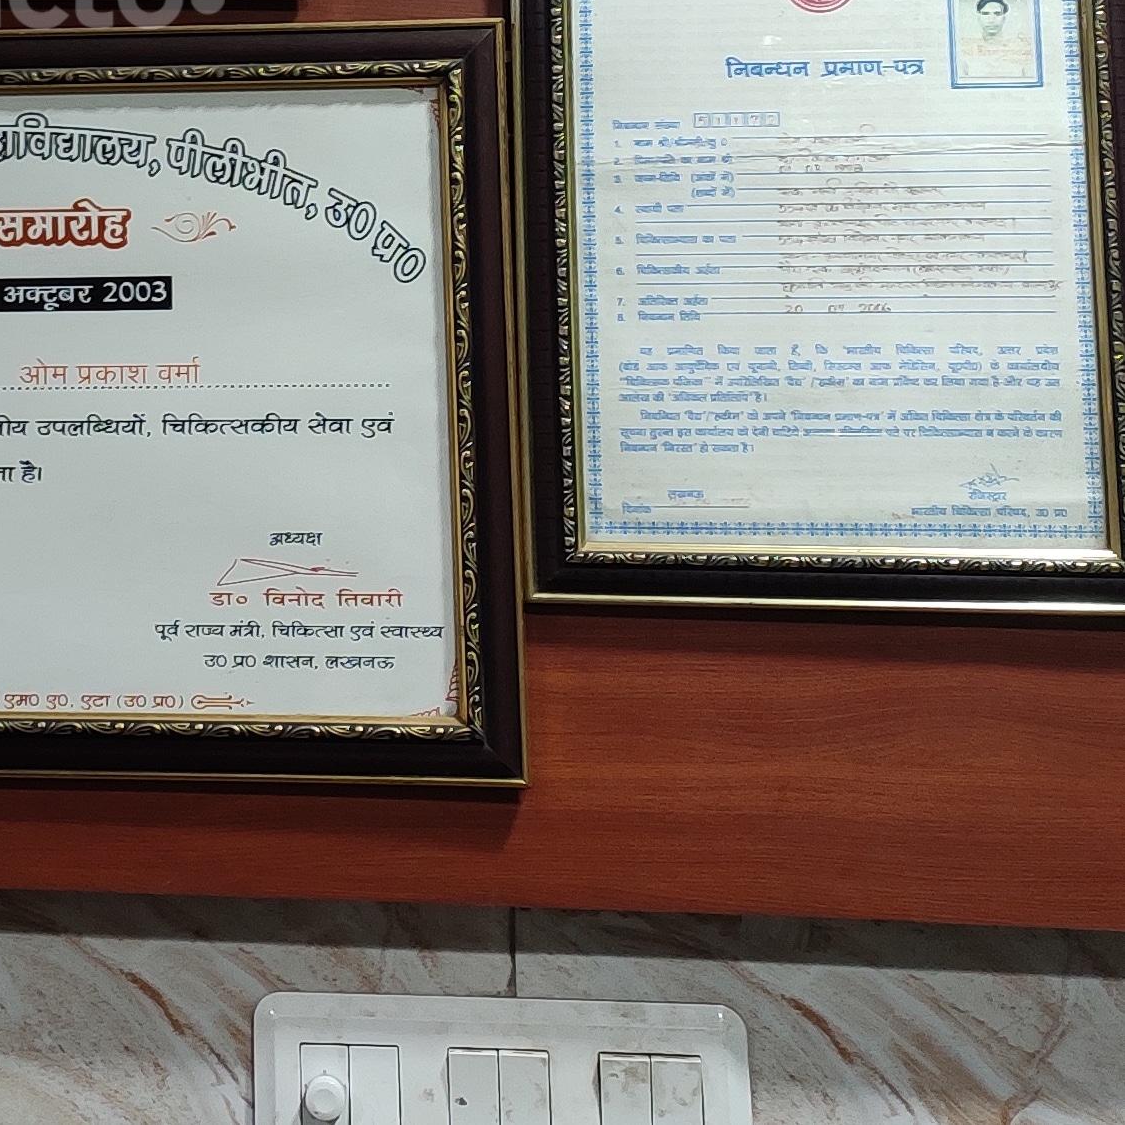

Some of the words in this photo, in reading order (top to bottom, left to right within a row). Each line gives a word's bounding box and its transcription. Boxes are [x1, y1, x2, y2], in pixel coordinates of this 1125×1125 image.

[725, 57, 809, 79] निबन्धन
[819, 57, 924, 79] प्रमाण-पत्र
[165, 128, 319, 221] पीलीभीत,
[3, 282, 94, 310] अक्टूबर
[102, 281, 168, 303] 2003
[20, 358, 69, 386] ओम
[75, 363, 148, 386] प्रकाश
[156, 356, 202, 385] वर्मा
[34, 413, 152, 438] उपलब्धियों,
[162, 413, 302, 437] चिकित्सकीय
[307, 411, 354, 436] सेवा
[361, 411, 395, 439] एवं
[19, 460, 43, 484] है।
[269, 531, 323, 547] अध्यक्ष
[262, 586, 326, 608] विनोद
[336, 587, 404, 608] तिवारी
[154, 620, 179, 642] पूर्व
[229, 620, 266, 639] मंत्री,
[272, 621, 344, 638] चिकित्सा
[349, 620, 376, 642] एवं
[262, 654, 319, 670] शासन,
[324, 654, 395, 671] लखनऊ
[81, 694, 110, 708] एटा
